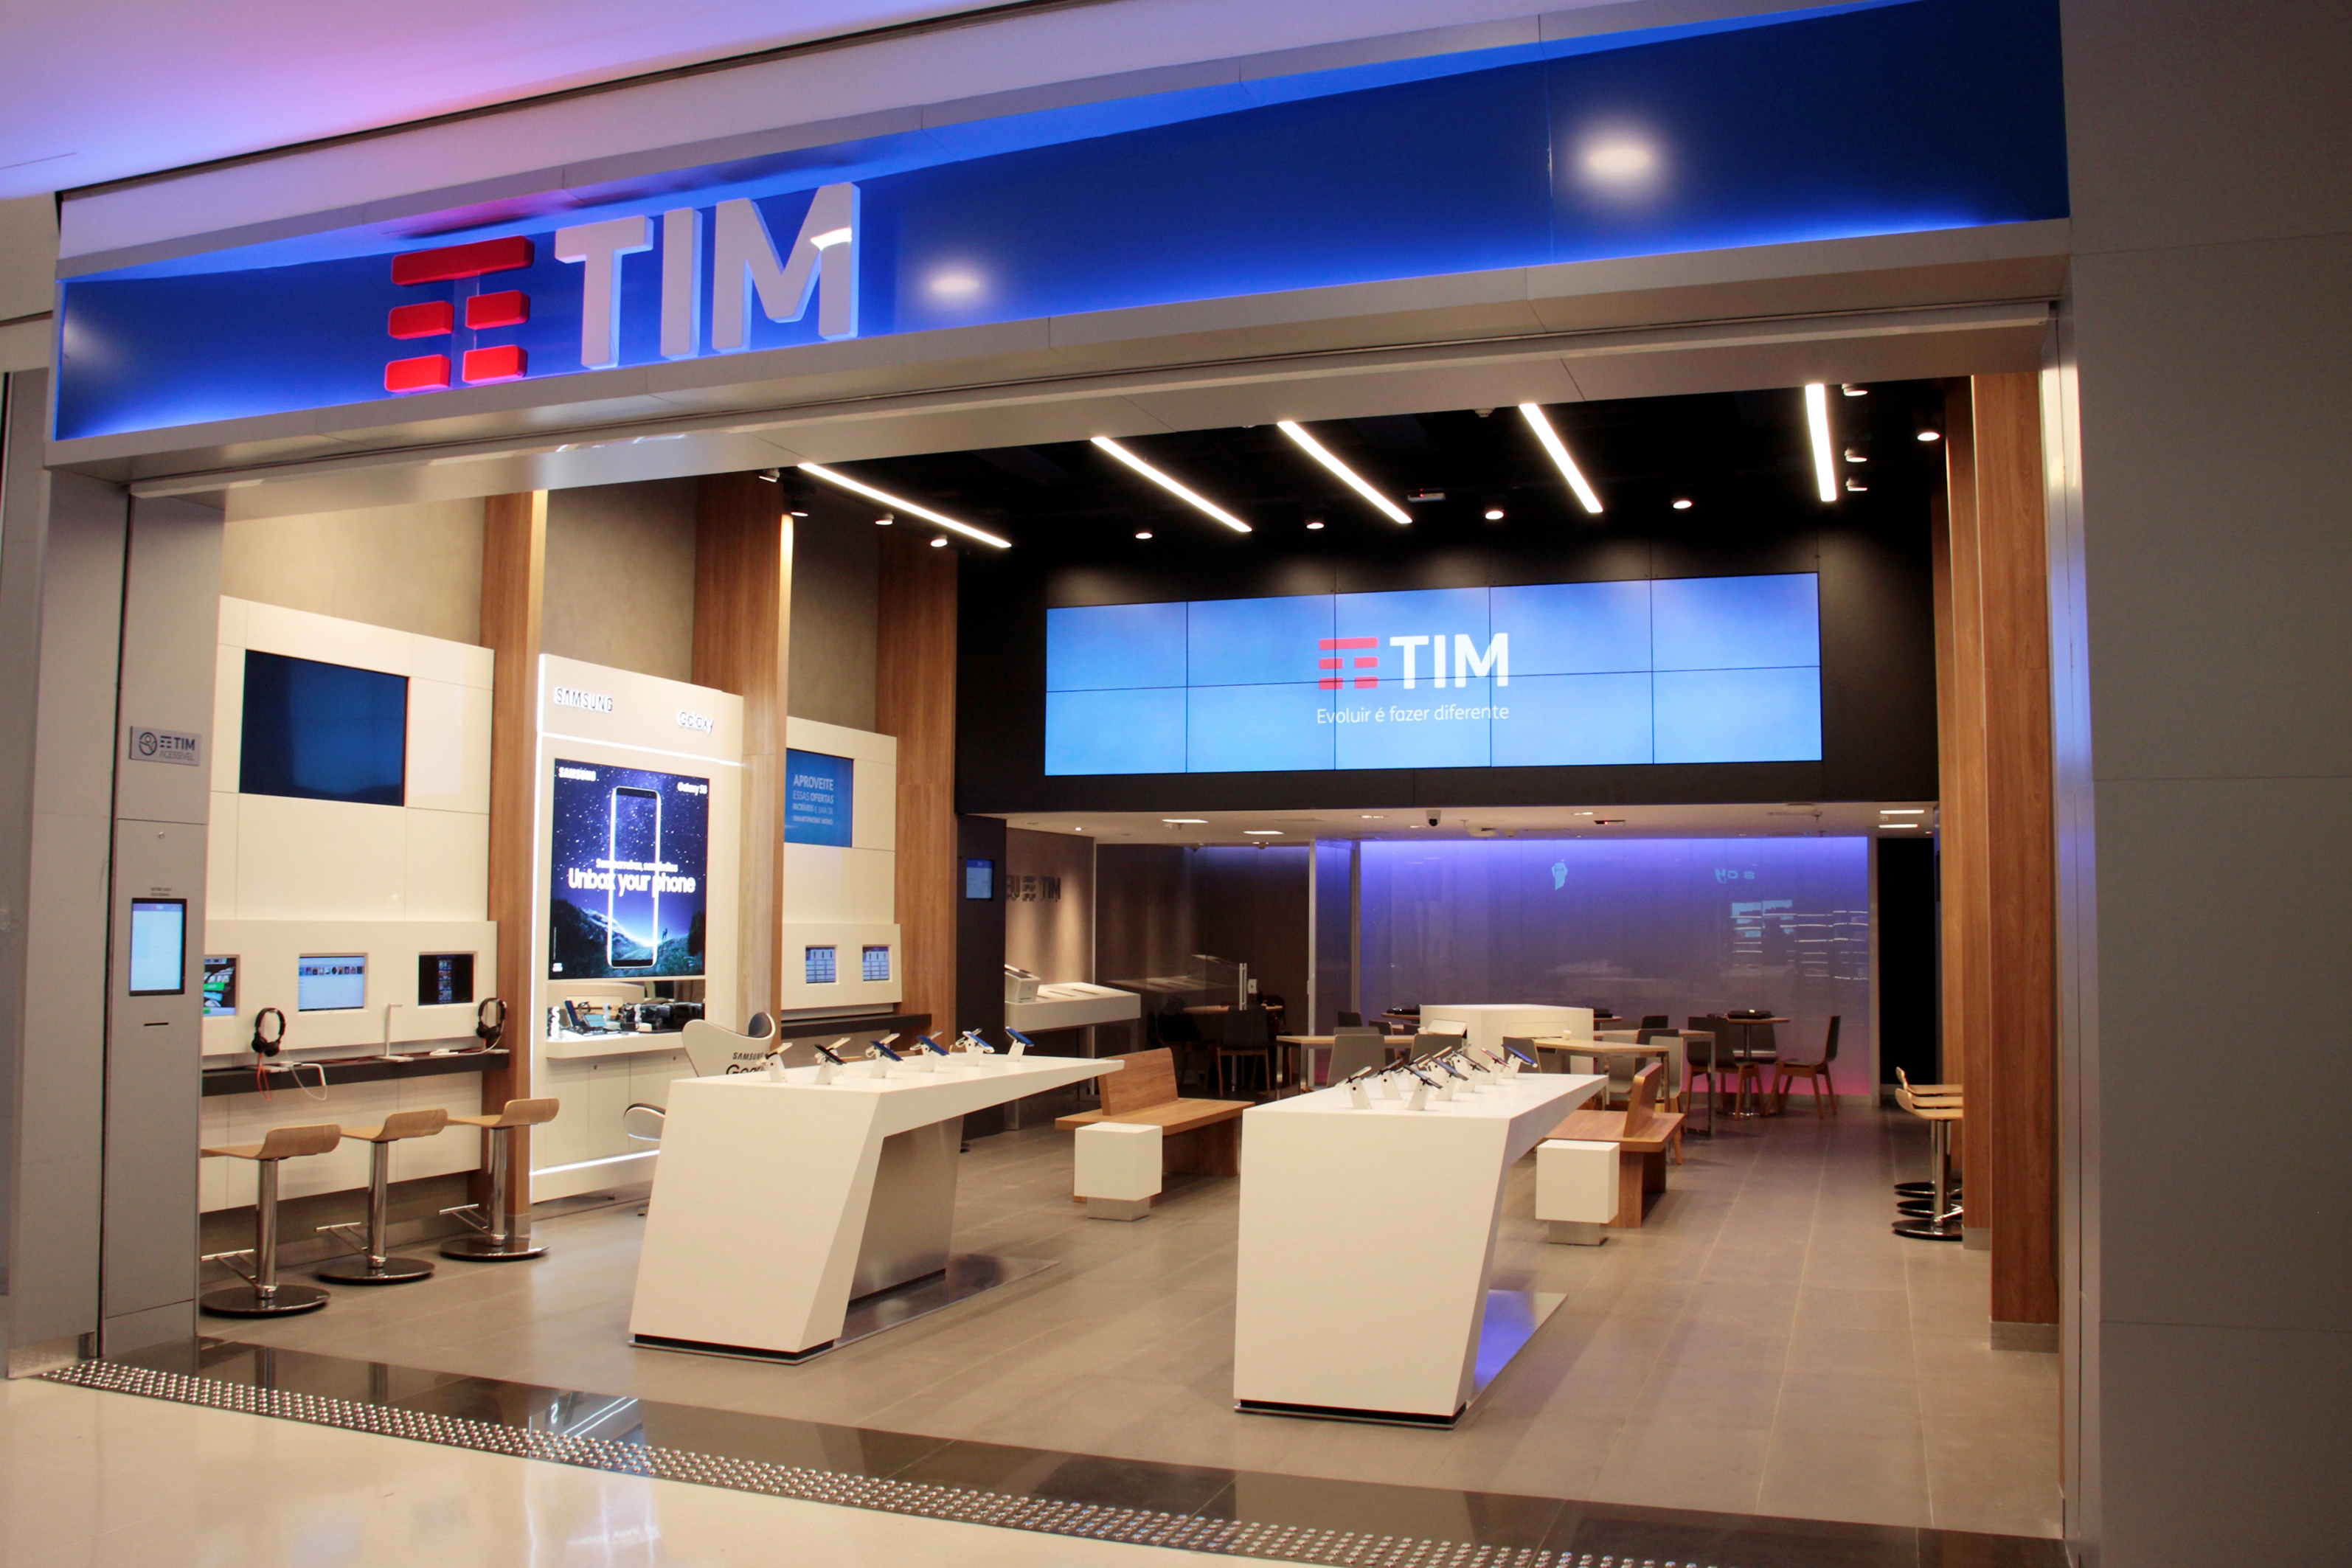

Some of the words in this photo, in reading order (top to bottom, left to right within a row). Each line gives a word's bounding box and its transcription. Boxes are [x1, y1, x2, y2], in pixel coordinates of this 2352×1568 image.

[555, 182, 860, 370] TIM
[1390, 633, 1508, 689] TIM
[555, 687, 613, 712] SAMSUNG
[678, 711, 714, 734] Galaxy
[1317, 707, 1371, 724] Evoluir
[1375, 707, 1385, 722] é
[1390, 705, 1430, 722] fazer
[1434, 704, 1509, 721] diferente
[174, 737, 195, 751] TIM
[558, 766, 597, 782] SAMSUNG
[793, 774, 834, 791] APROVEITE
[793, 790, 810, 801] ESSAS
[811, 792, 834, 804] OFERTAS
[569, 868, 616, 890] Unbox
[617, 873, 651, 898] your
[652, 873, 696, 898] phone
